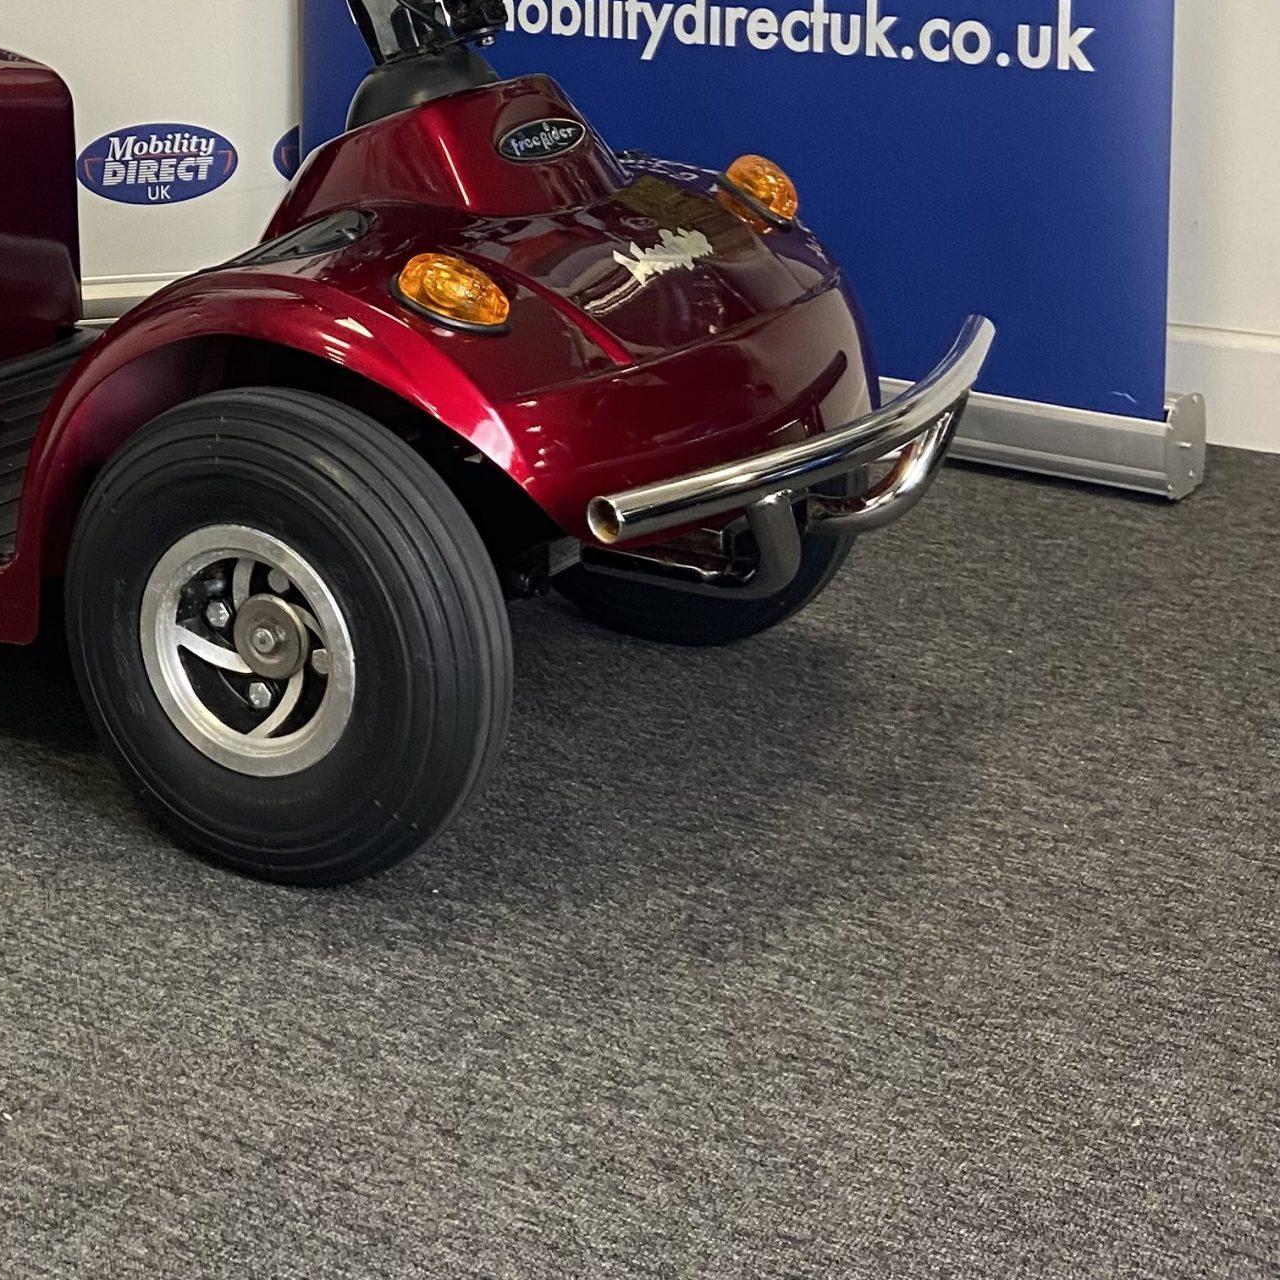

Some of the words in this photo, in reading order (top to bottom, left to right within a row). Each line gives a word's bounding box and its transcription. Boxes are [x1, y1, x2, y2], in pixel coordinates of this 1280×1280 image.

[106, 133, 214, 161] Mobility
[104, 157, 213, 185] DIRECT
[149, 185, 170, 200] UK
